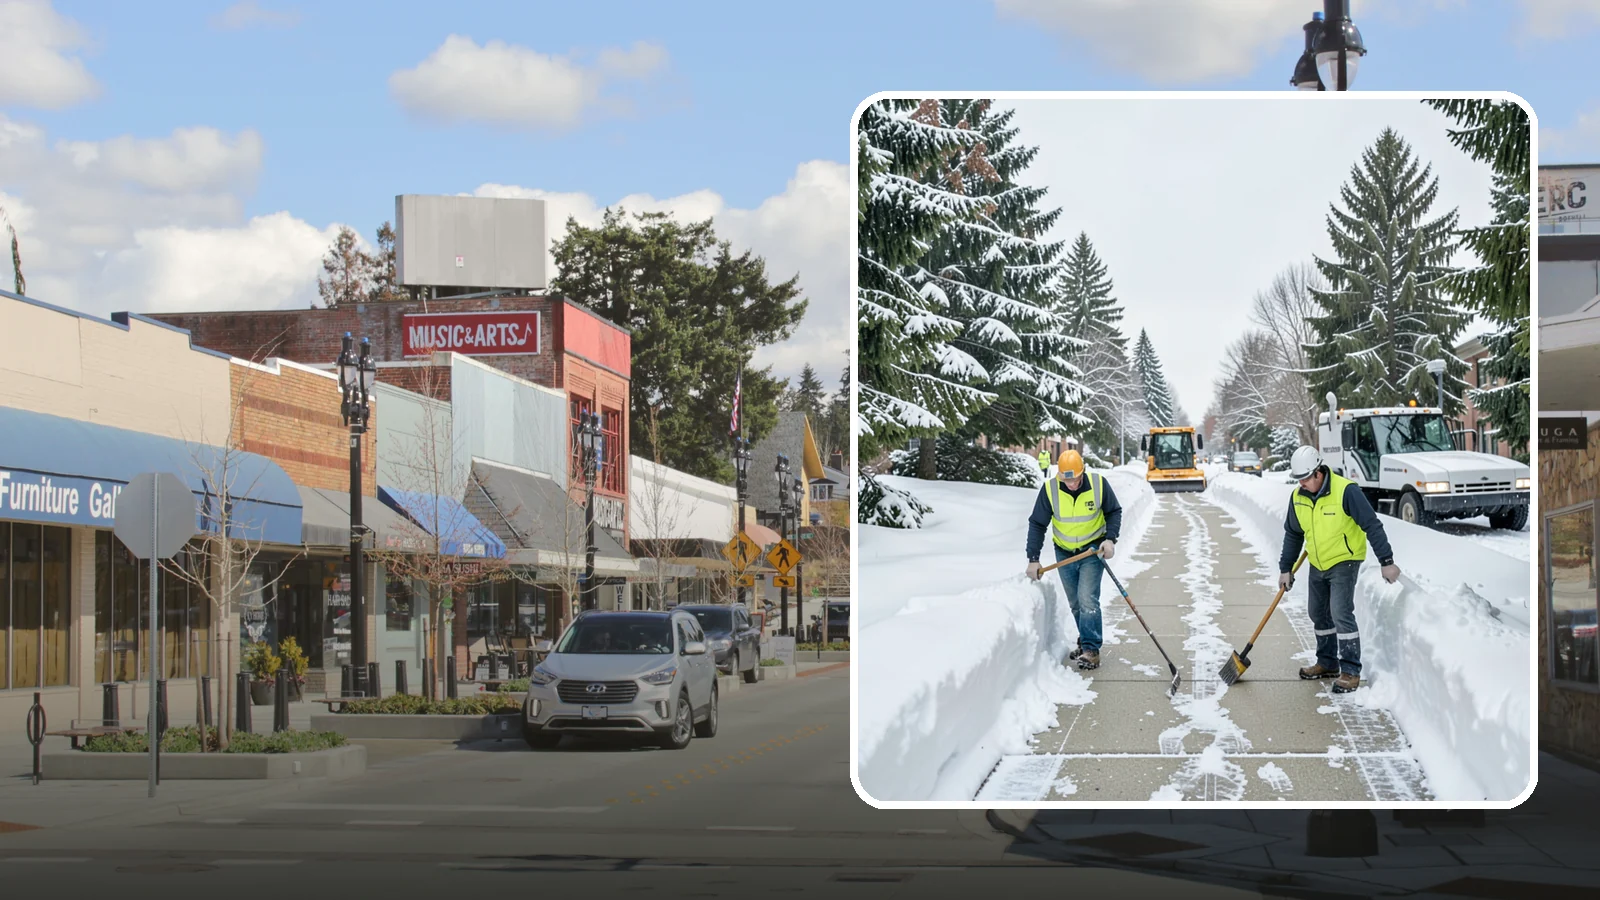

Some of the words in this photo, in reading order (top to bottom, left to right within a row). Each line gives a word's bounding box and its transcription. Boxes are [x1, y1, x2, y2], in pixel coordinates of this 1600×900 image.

[408, 322, 520, 349] MUSIC&ARTS
[0, 471, 79, 515] Furniture
[89, 482, 122, 519] Gal
